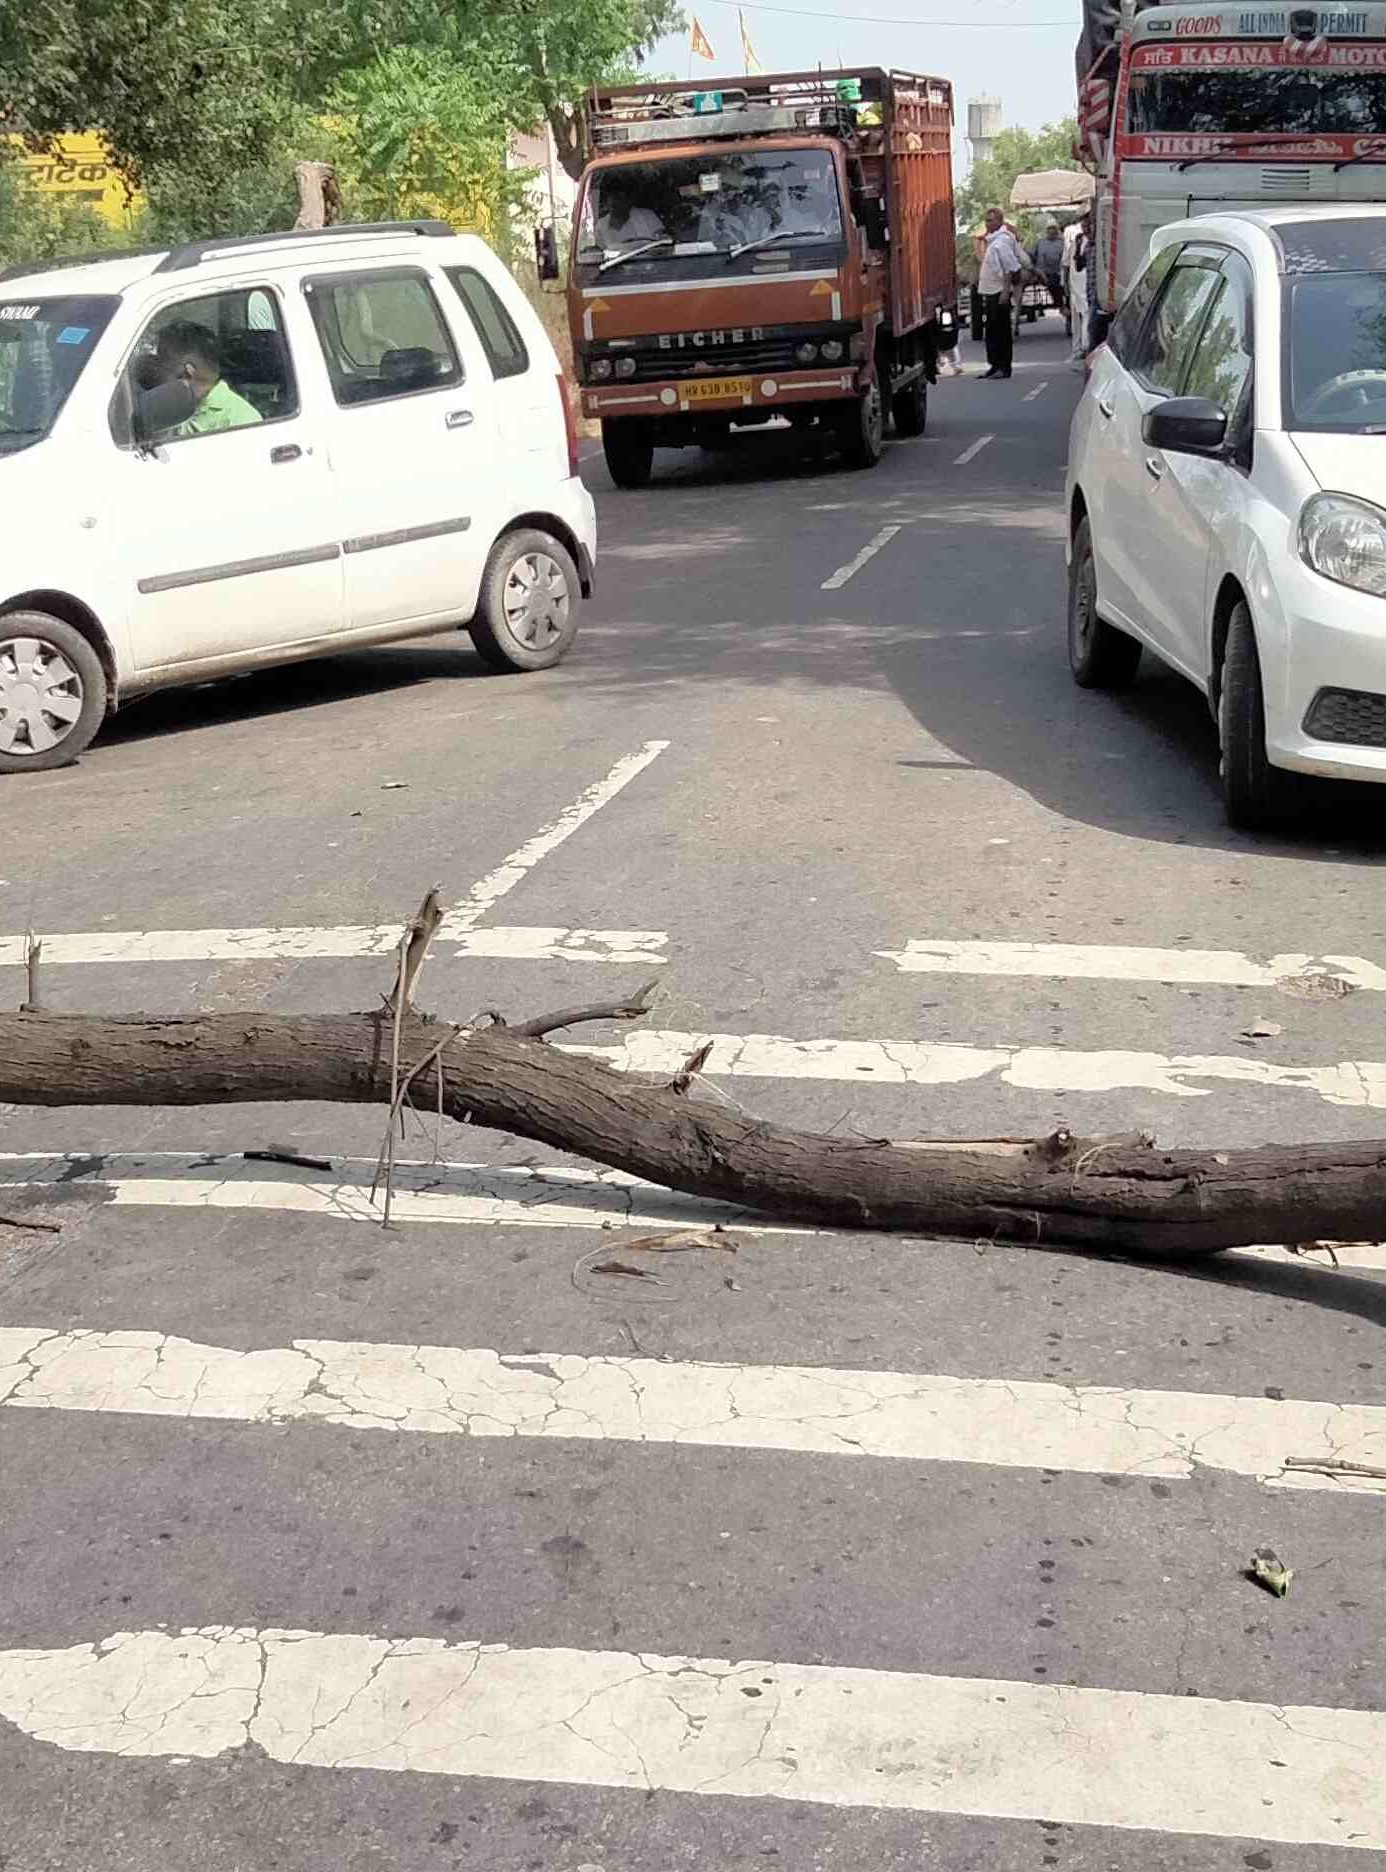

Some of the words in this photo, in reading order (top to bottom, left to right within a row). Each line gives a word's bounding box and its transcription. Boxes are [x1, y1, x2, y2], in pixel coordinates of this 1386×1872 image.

[1175, 15, 1222, 35] GOODS
[1321, 13, 1368, 33] PERMIT
[1180, 47, 1274, 64] KASANA
[659, 327, 765, 349] EICHER
